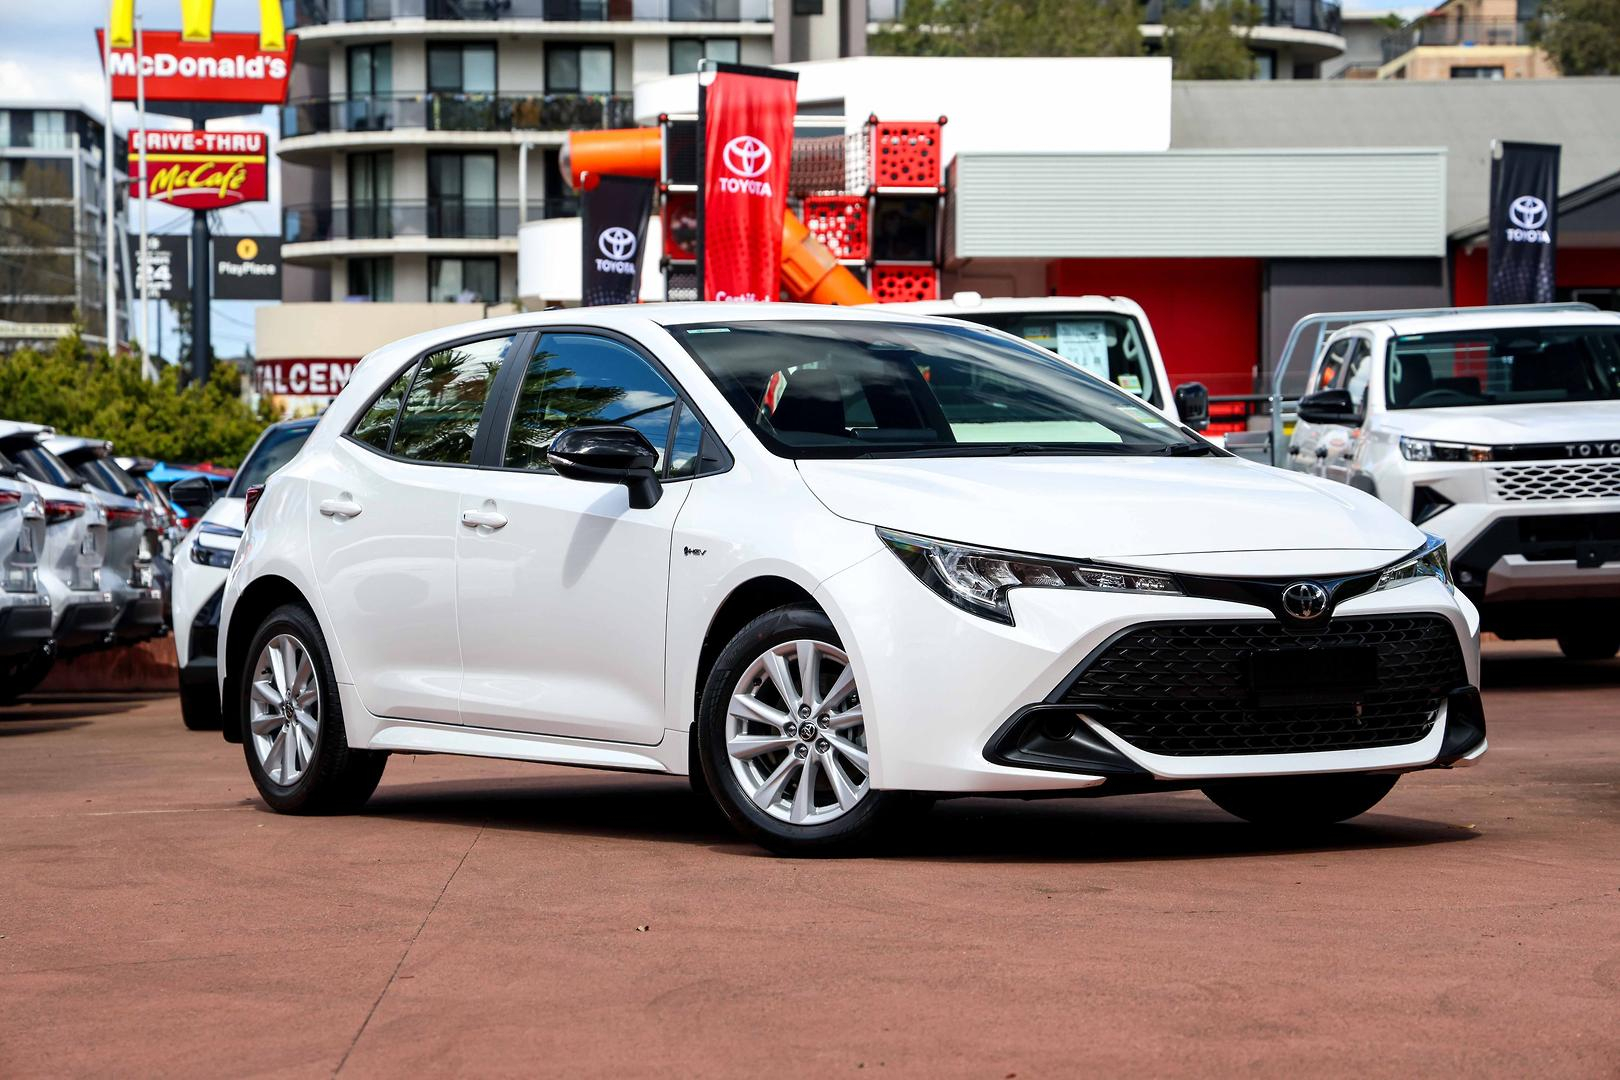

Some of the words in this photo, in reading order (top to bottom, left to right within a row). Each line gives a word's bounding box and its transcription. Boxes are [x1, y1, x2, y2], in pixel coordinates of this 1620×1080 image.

[109, 52, 287, 79] McDonald's
[150, 161, 247, 200] McCafé
[719, 177, 772, 197] TOYOTA
[1506, 228, 1551, 244] TOYOTA
[218, 260, 276, 277] PlayPlace
[595, 258, 636, 274] TOYOTA
